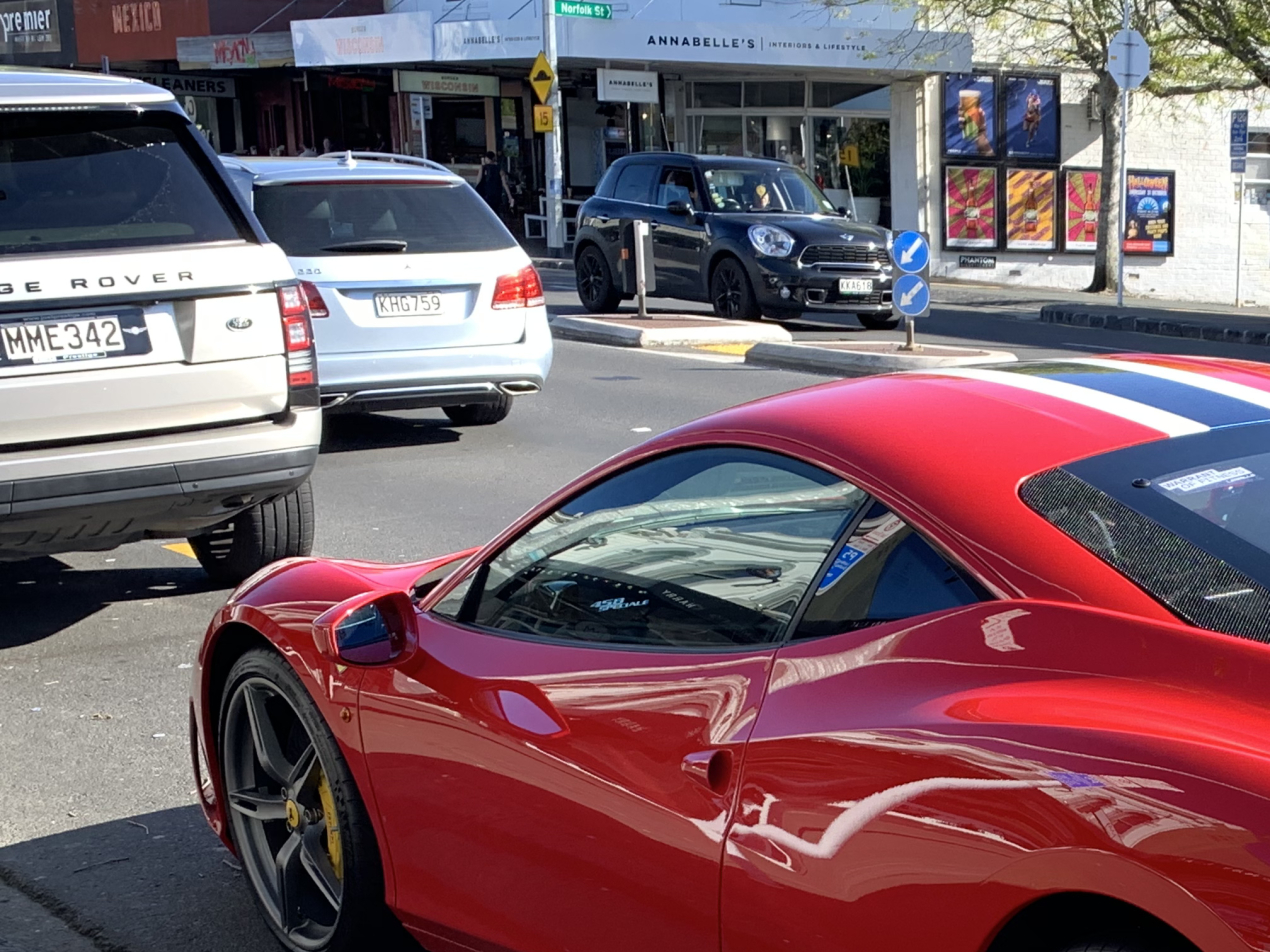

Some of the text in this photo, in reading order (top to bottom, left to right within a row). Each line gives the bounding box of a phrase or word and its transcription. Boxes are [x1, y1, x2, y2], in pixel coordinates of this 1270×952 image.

[112, 1, 162, 33] MEXICO
[561, 2, 604, 17] Norfolk St
[0, 9, 51, 43] premier
[463, 35, 500, 45] ANNABELLE'S
[647, 34, 755, 49] ANNABELLE'S
[768, 41, 812, 49] INTERIORS
[823, 43, 867, 51] LIFESTYLE
[421, 80, 479, 93] WISCONSIN
[608, 79, 653, 88] ANNABELLE'S
[540, 111, 549, 127] 15
[1127, 174, 1169, 190] HALLOWEEN
[960, 256, 995, 264] PHANTOM
[71, 271, 194, 290] ROVER
[380, 295, 441, 313] KHG759
[5, 320, 121, 355] MME342
[1164, 470, 1216, 488] WARRANT
[1180, 468, 1246, 490] OF FITNESS
